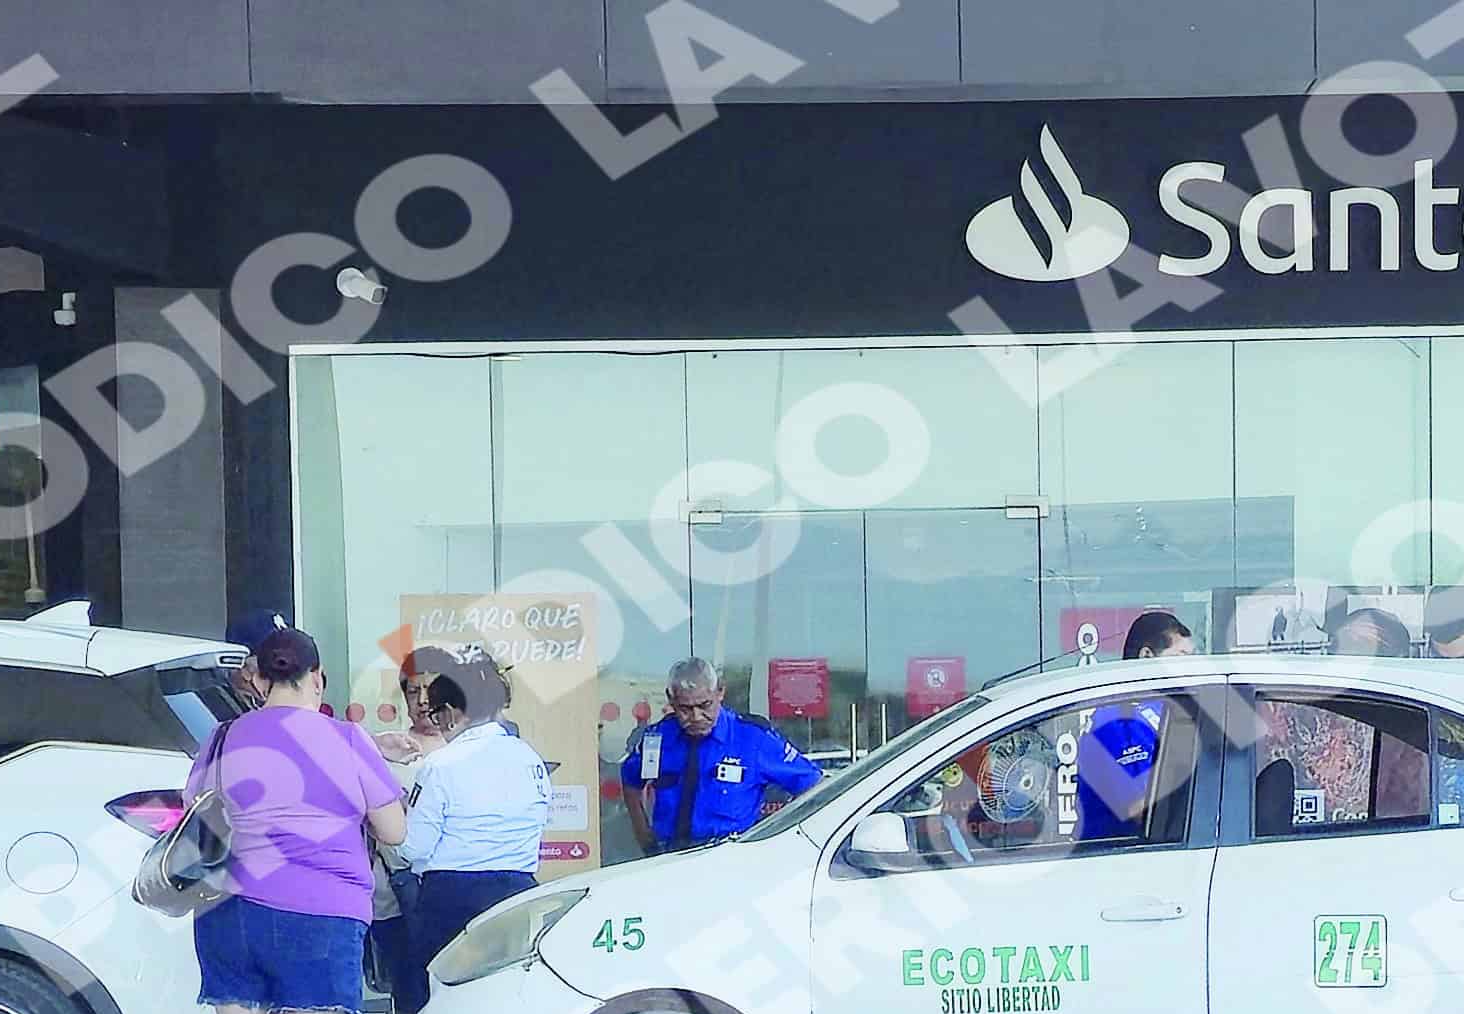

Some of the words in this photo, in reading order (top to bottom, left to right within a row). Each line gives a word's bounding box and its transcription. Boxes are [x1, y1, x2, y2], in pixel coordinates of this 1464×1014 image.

[524, 603, 581, 629] QUE
[492, 636, 586, 664] PUEDE!
[592, 916, 645, 952] 45
[902, 944, 1090, 986] ECOTAXI
[1318, 920, 1383, 983] 274
[941, 988, 982, 1014] SITIO
[987, 985, 1062, 1013] LIBERTAD
